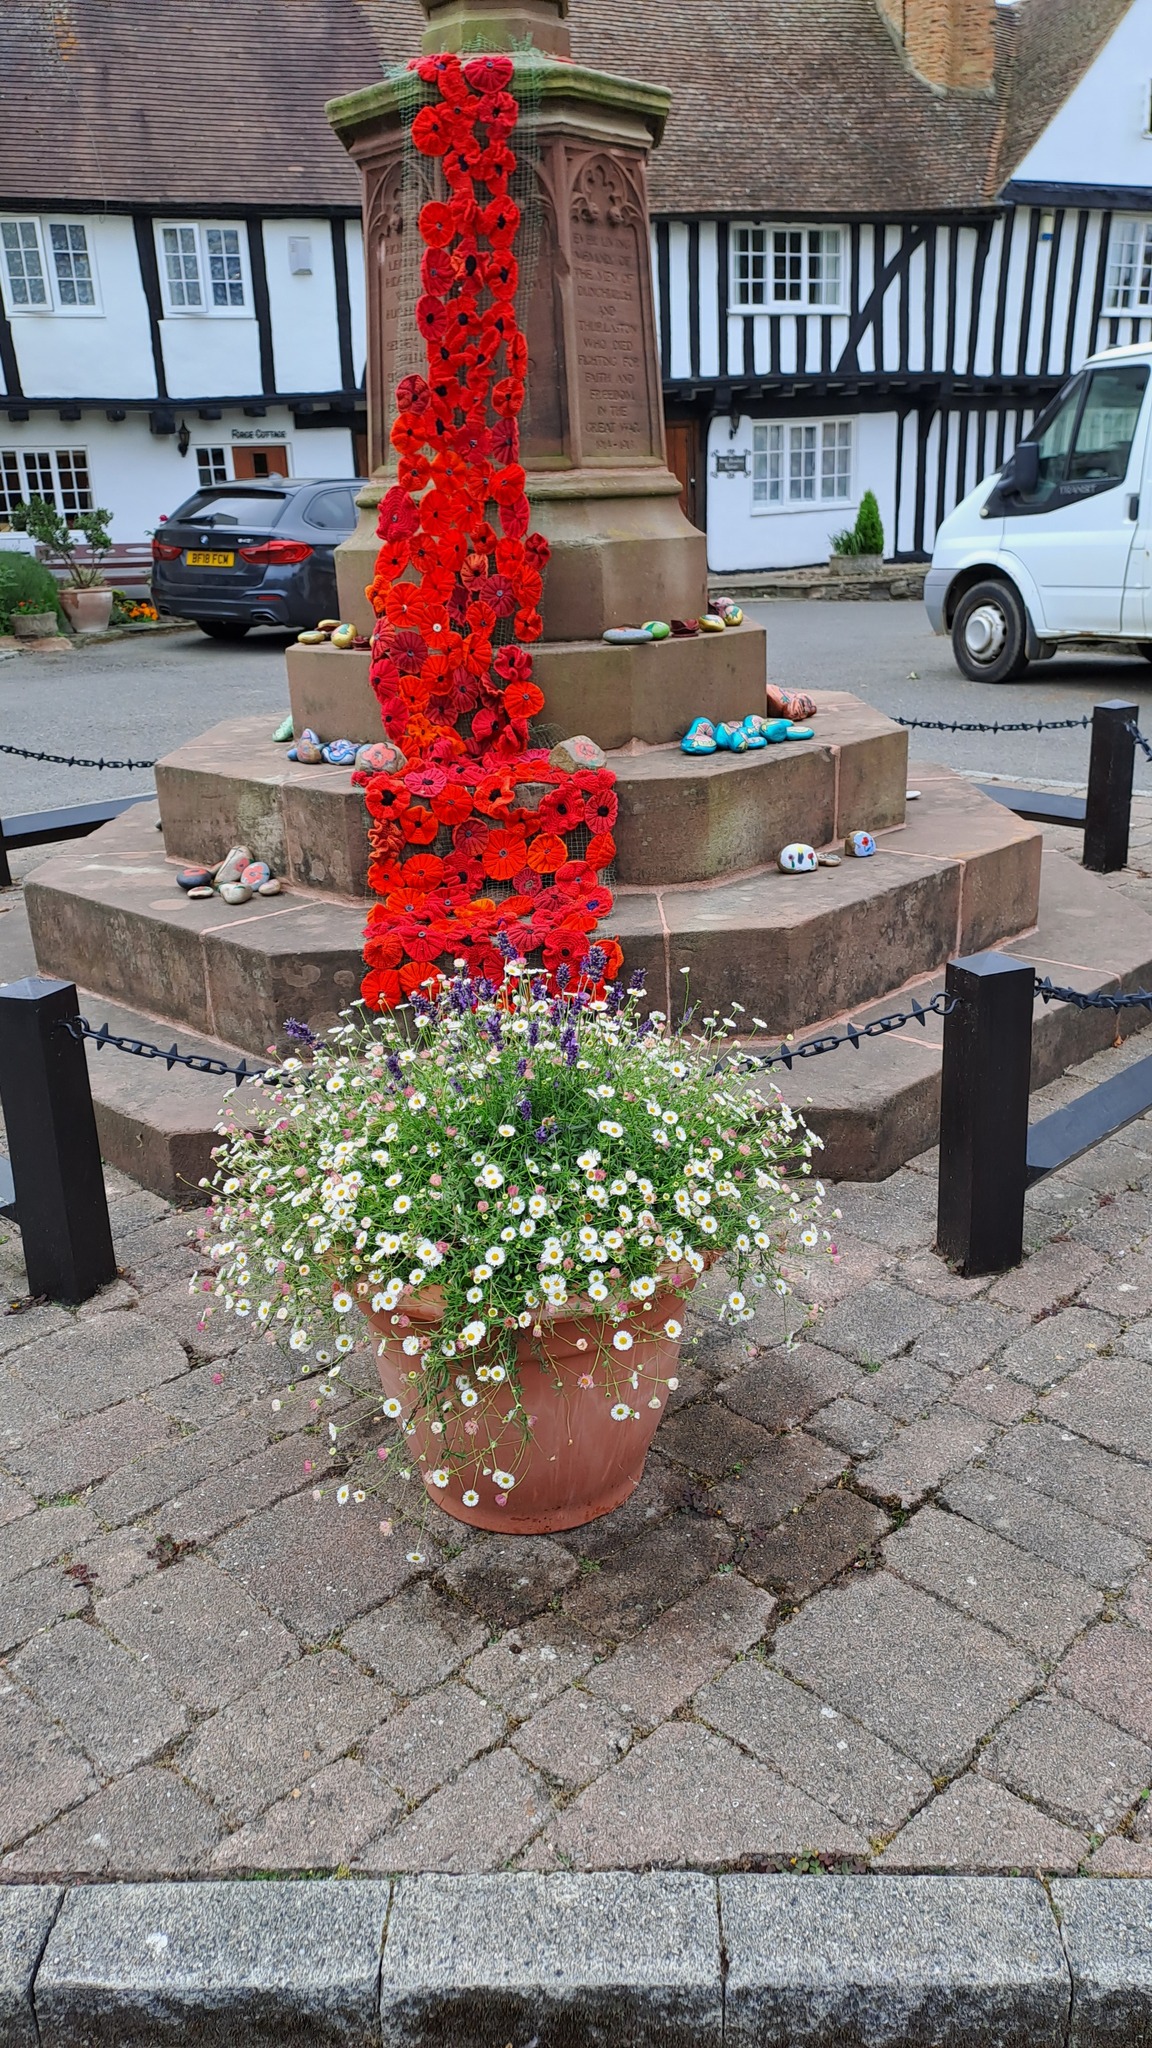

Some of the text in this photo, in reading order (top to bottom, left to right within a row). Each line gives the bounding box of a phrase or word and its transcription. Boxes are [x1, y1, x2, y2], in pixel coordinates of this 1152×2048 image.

[583, 338, 607, 350] WHO
[609, 405, 629, 417] THE
[192, 553, 210, 564] BF18
